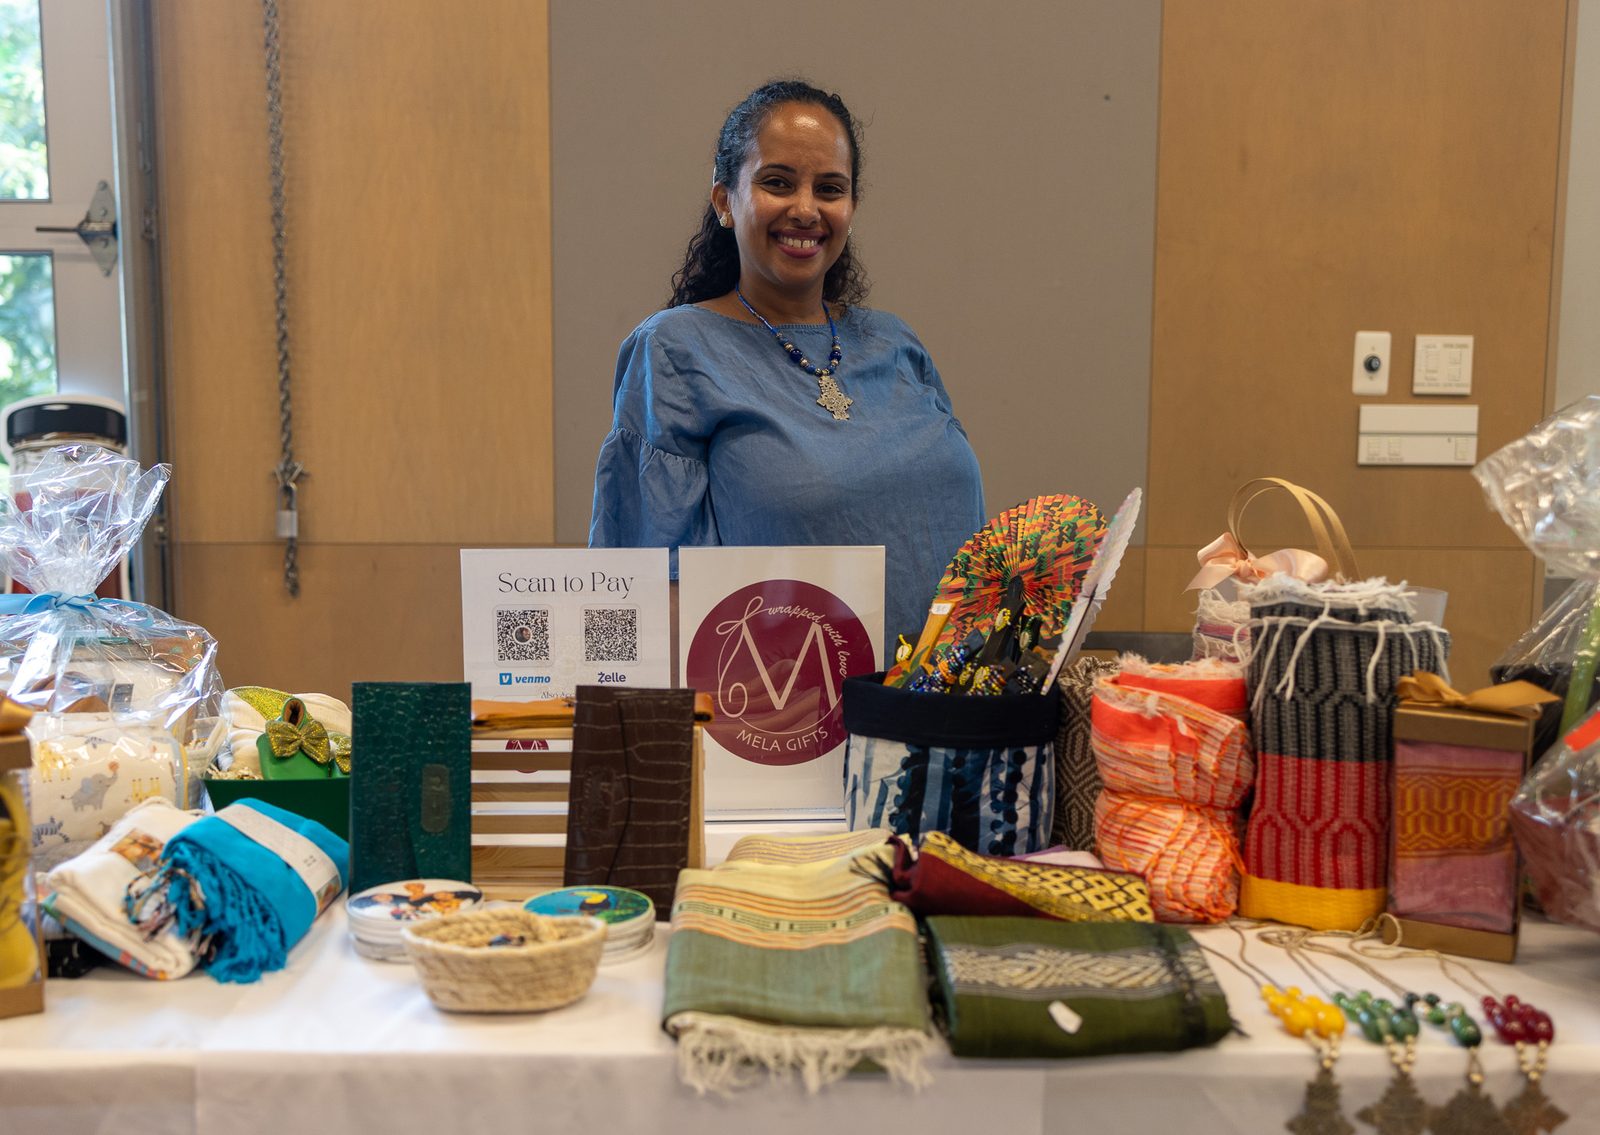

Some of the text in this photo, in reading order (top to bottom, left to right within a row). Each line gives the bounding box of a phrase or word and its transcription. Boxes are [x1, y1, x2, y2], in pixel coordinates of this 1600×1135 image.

[498, 571, 634, 600] Scan to Pay
[767, 604, 851, 679] wrapped with love
[515, 675, 551, 684] venmo
[597, 671, 627, 684] Zelle
[736, 726, 828, 752] MELA GIFTS
